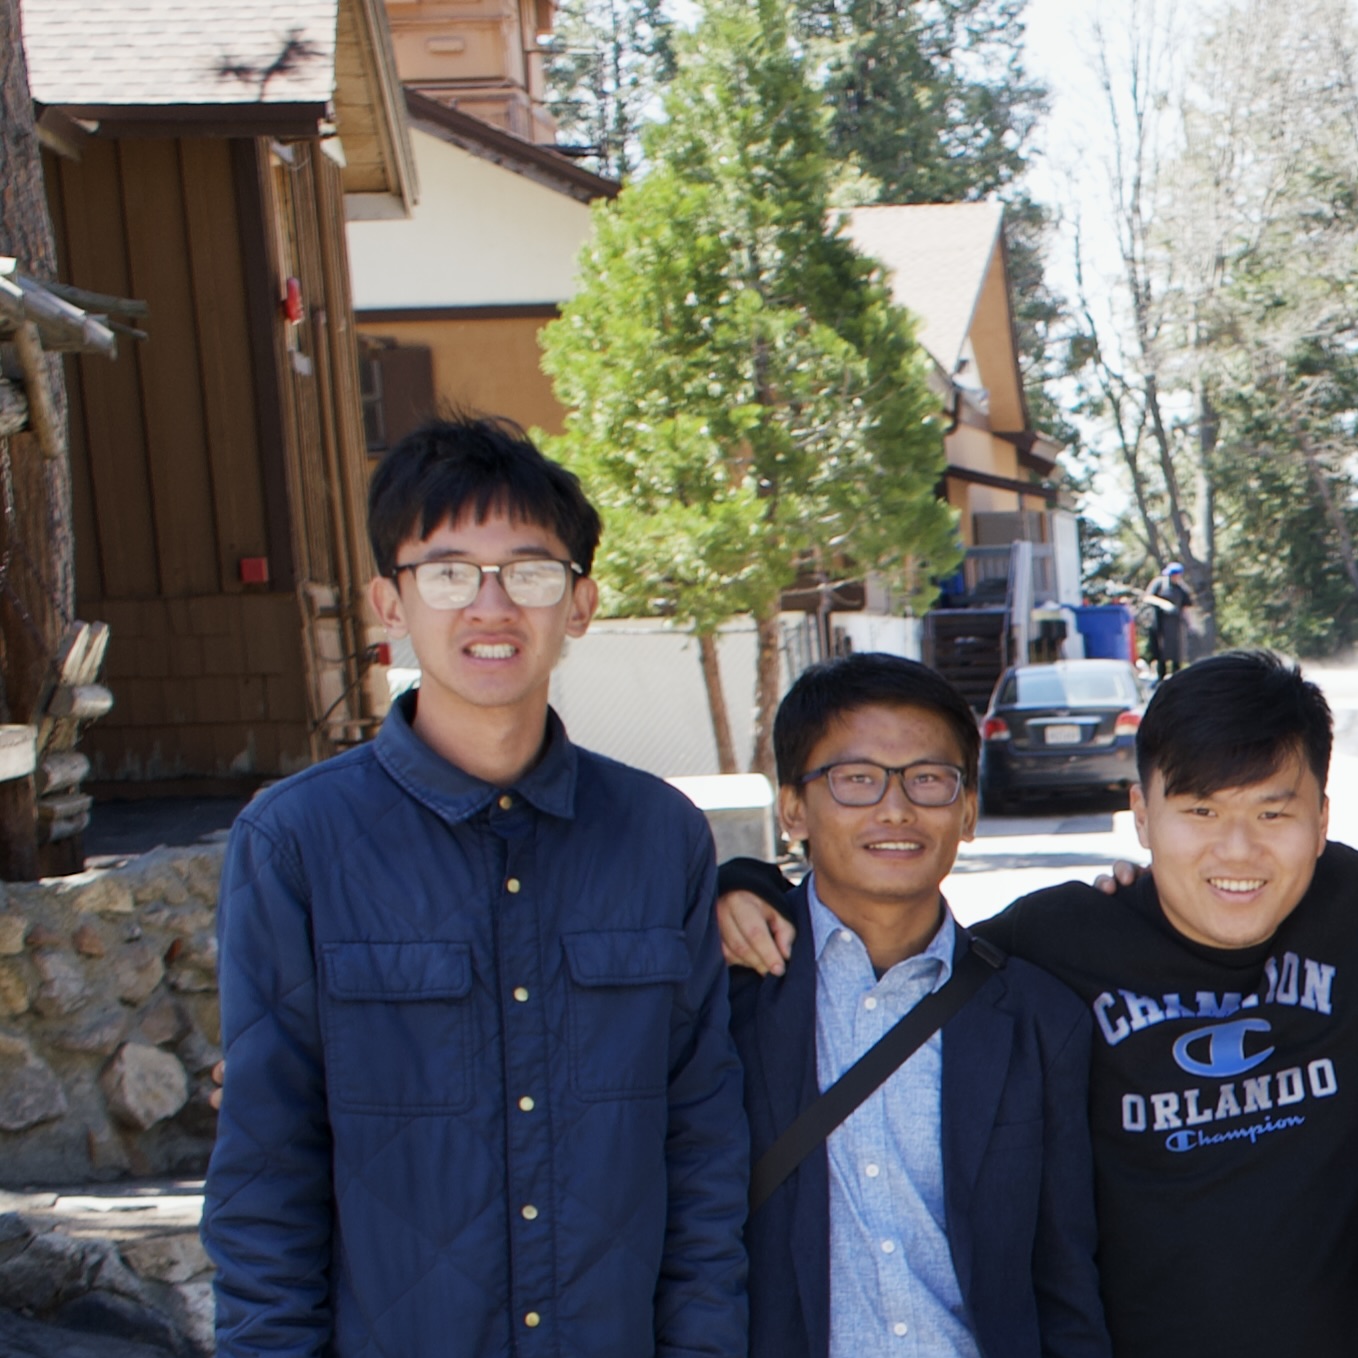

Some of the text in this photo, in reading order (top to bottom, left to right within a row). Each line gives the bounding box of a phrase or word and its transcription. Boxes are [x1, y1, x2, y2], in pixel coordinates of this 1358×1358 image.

[1092, 951, 1336, 1047] CHAMION
[1121, 1057, 1338, 1132] ORLANDO
[1165, 1115, 1305, 1152] Champion
